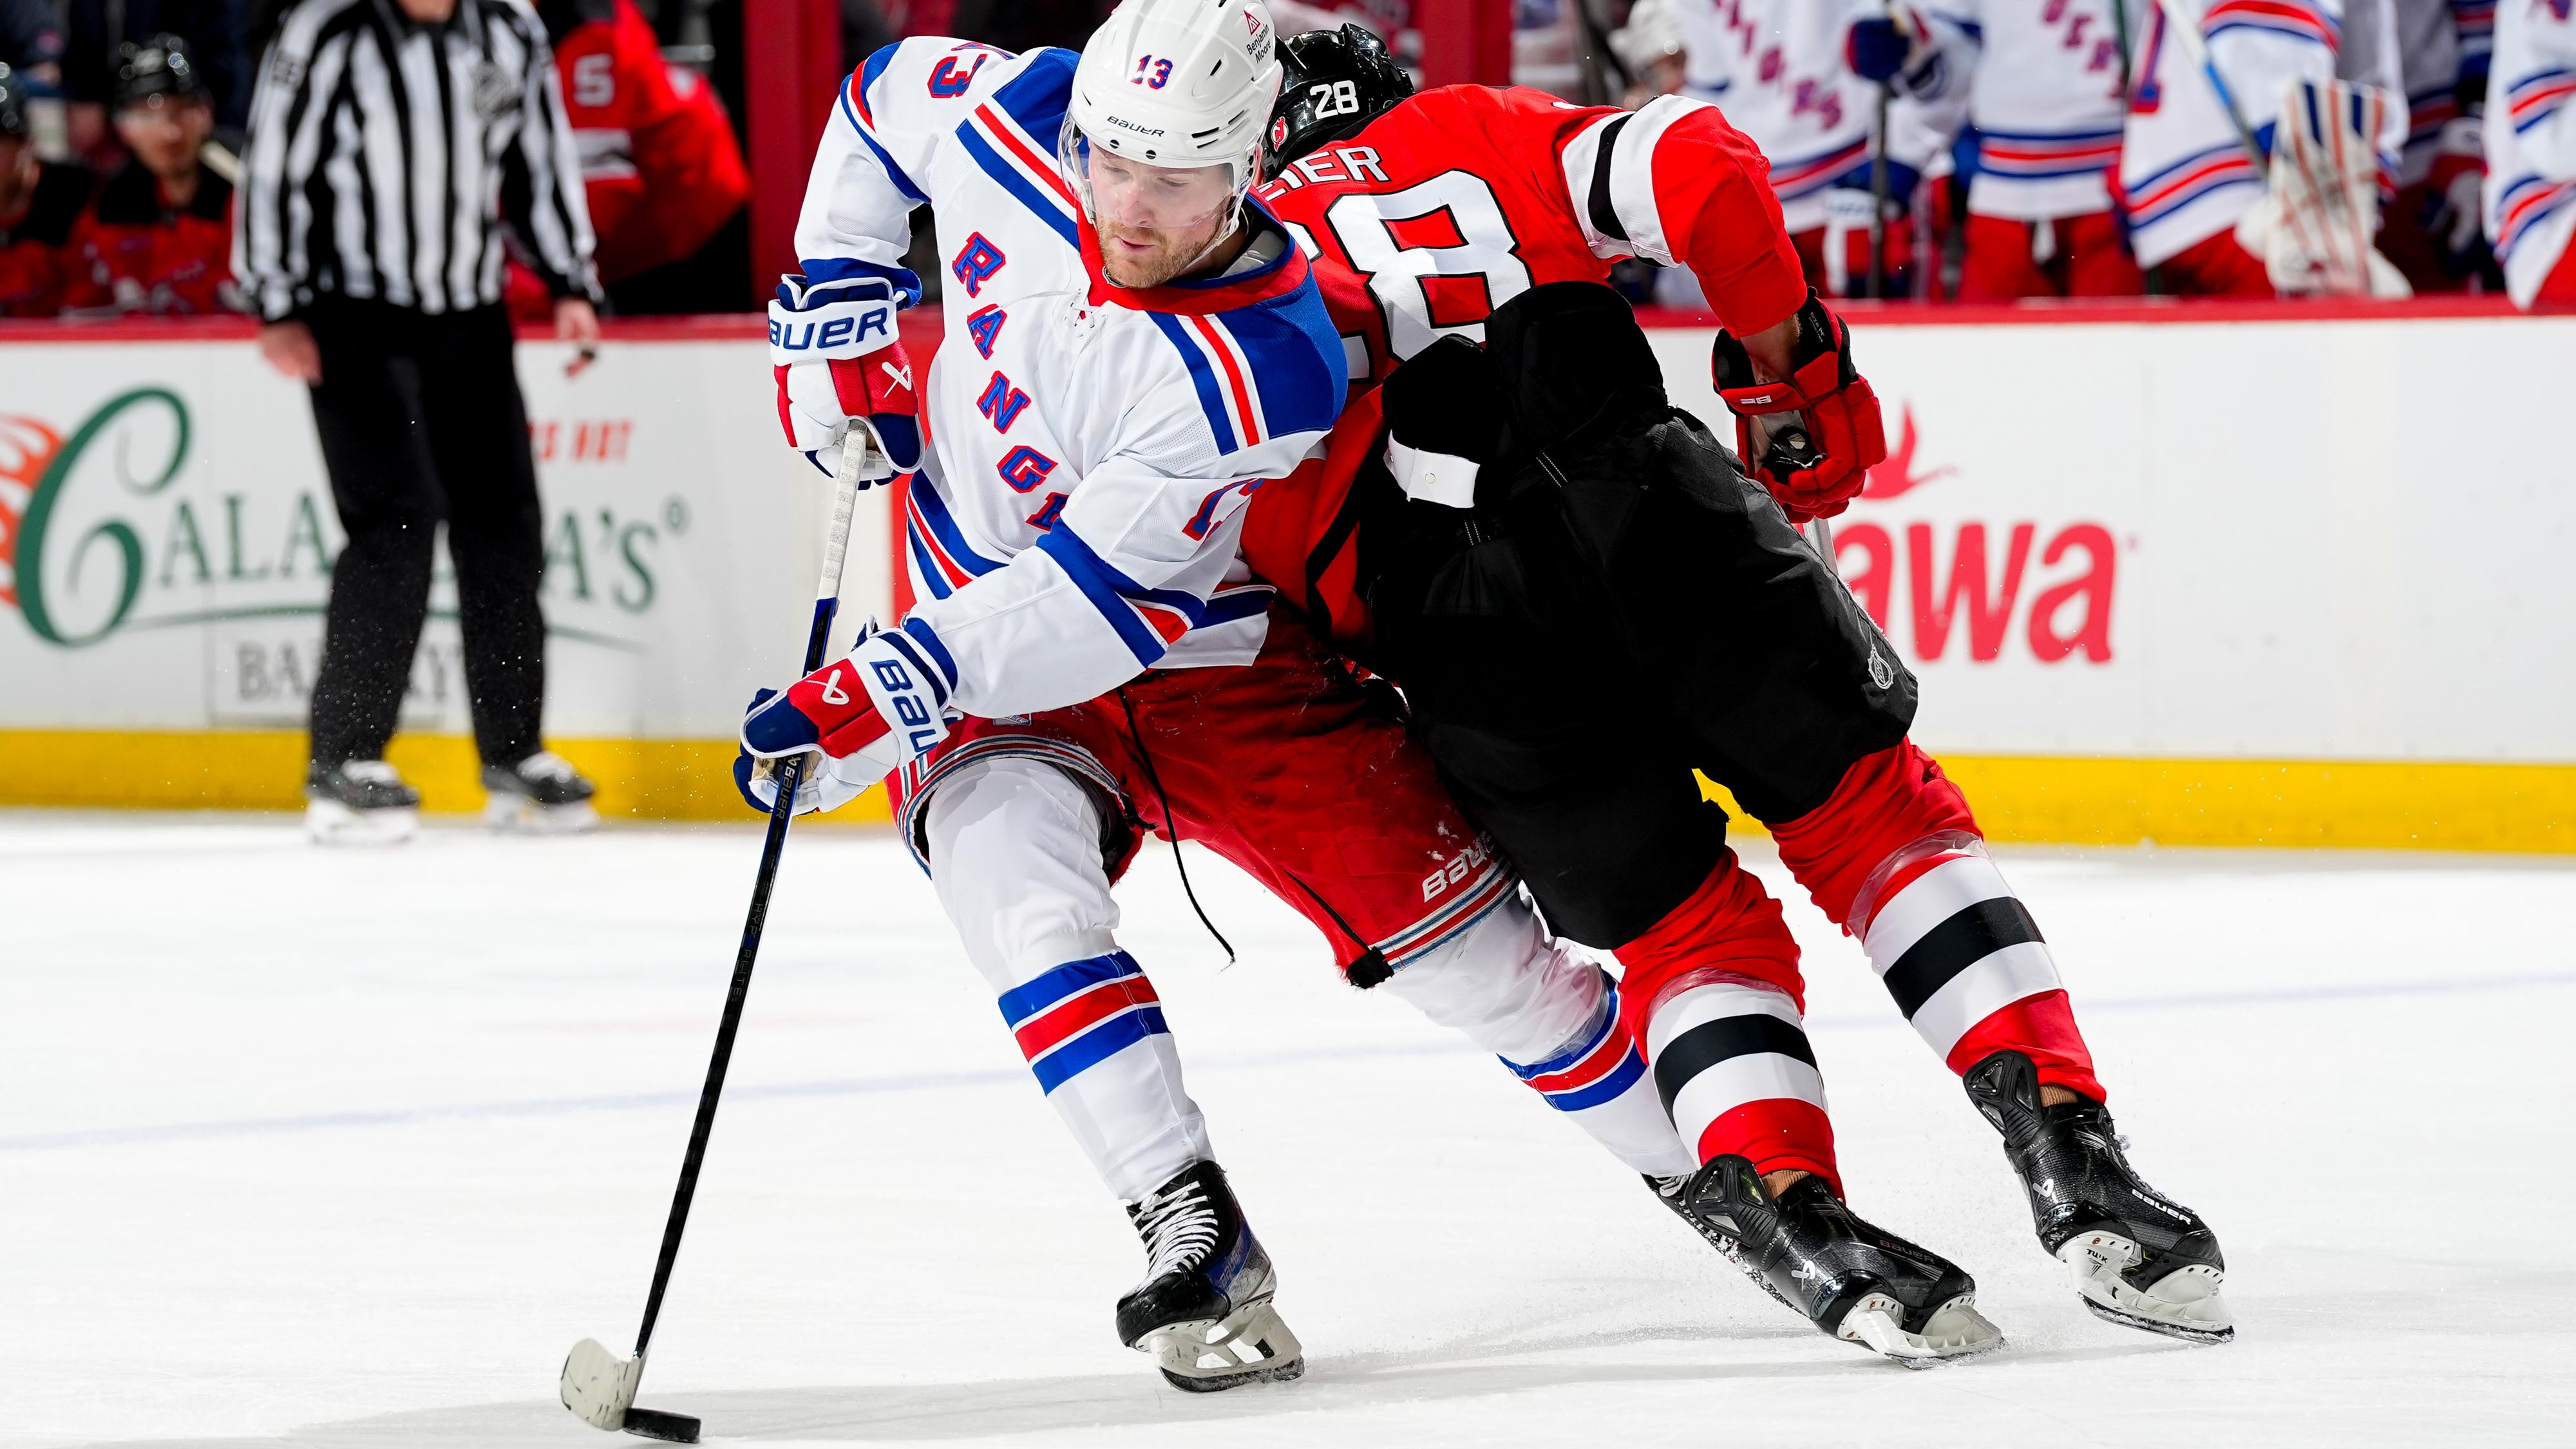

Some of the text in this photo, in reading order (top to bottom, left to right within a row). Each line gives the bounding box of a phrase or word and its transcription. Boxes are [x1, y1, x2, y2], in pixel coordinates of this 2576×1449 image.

[1246, 24, 1269, 55] Benjamin
[1255, 39, 1271, 64] Moore
[1130, 55, 1173, 90] 13
[1309, 80, 1359, 120] 28
[770, 307, 887, 350] AUER
[952, 232, 1069, 531] RANGE
[573, 422, 633, 462] HOT
[14, 385, 658, 648] CALAA'S
[1833, 522, 2116, 664] awa
[869, 659, 939, 759] BAU
[733, 903, 763, 996] HYPRLITE
